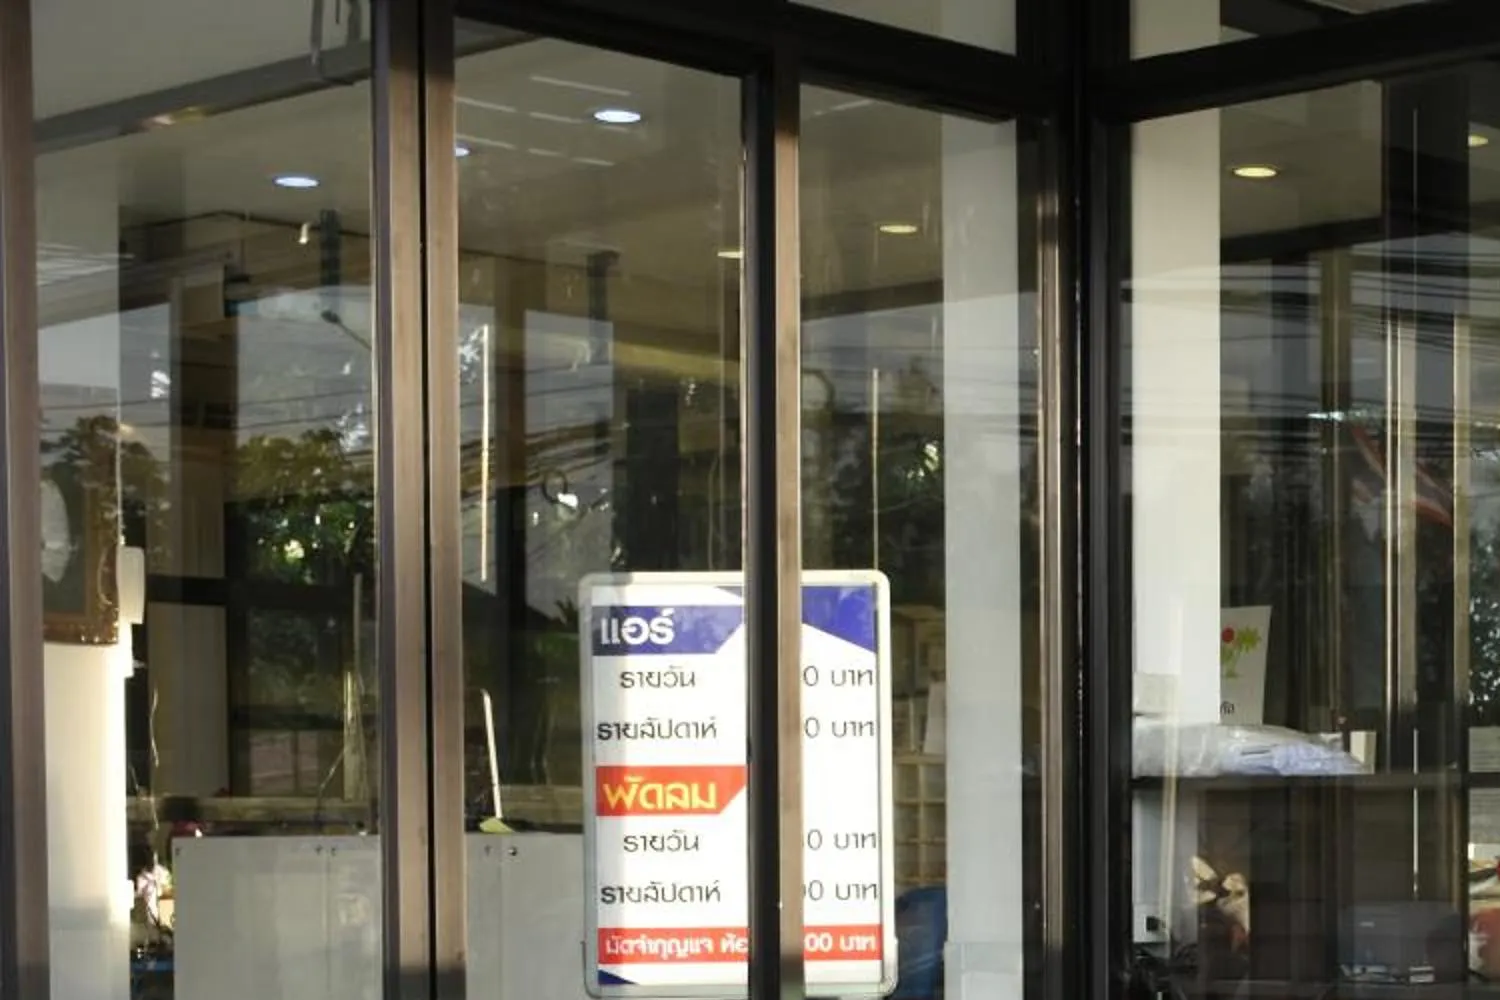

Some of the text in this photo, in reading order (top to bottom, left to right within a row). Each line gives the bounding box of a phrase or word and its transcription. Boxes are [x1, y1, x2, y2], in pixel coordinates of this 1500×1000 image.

[601, 607, 675, 645] แอร์
[620, 664, 873, 689] รายวัน 0 บาท
[597, 715, 875, 741] รายสัปดาห์ 0 บาท
[603, 775, 718, 811] พัดลม
[623, 828, 877, 852] รายวัน 0 บาท
[601, 879, 877, 904] รายสัปดาห์ 0 บาท
[804, 931, 833, 953] 00
[840, 933, 877, 951] บาท
